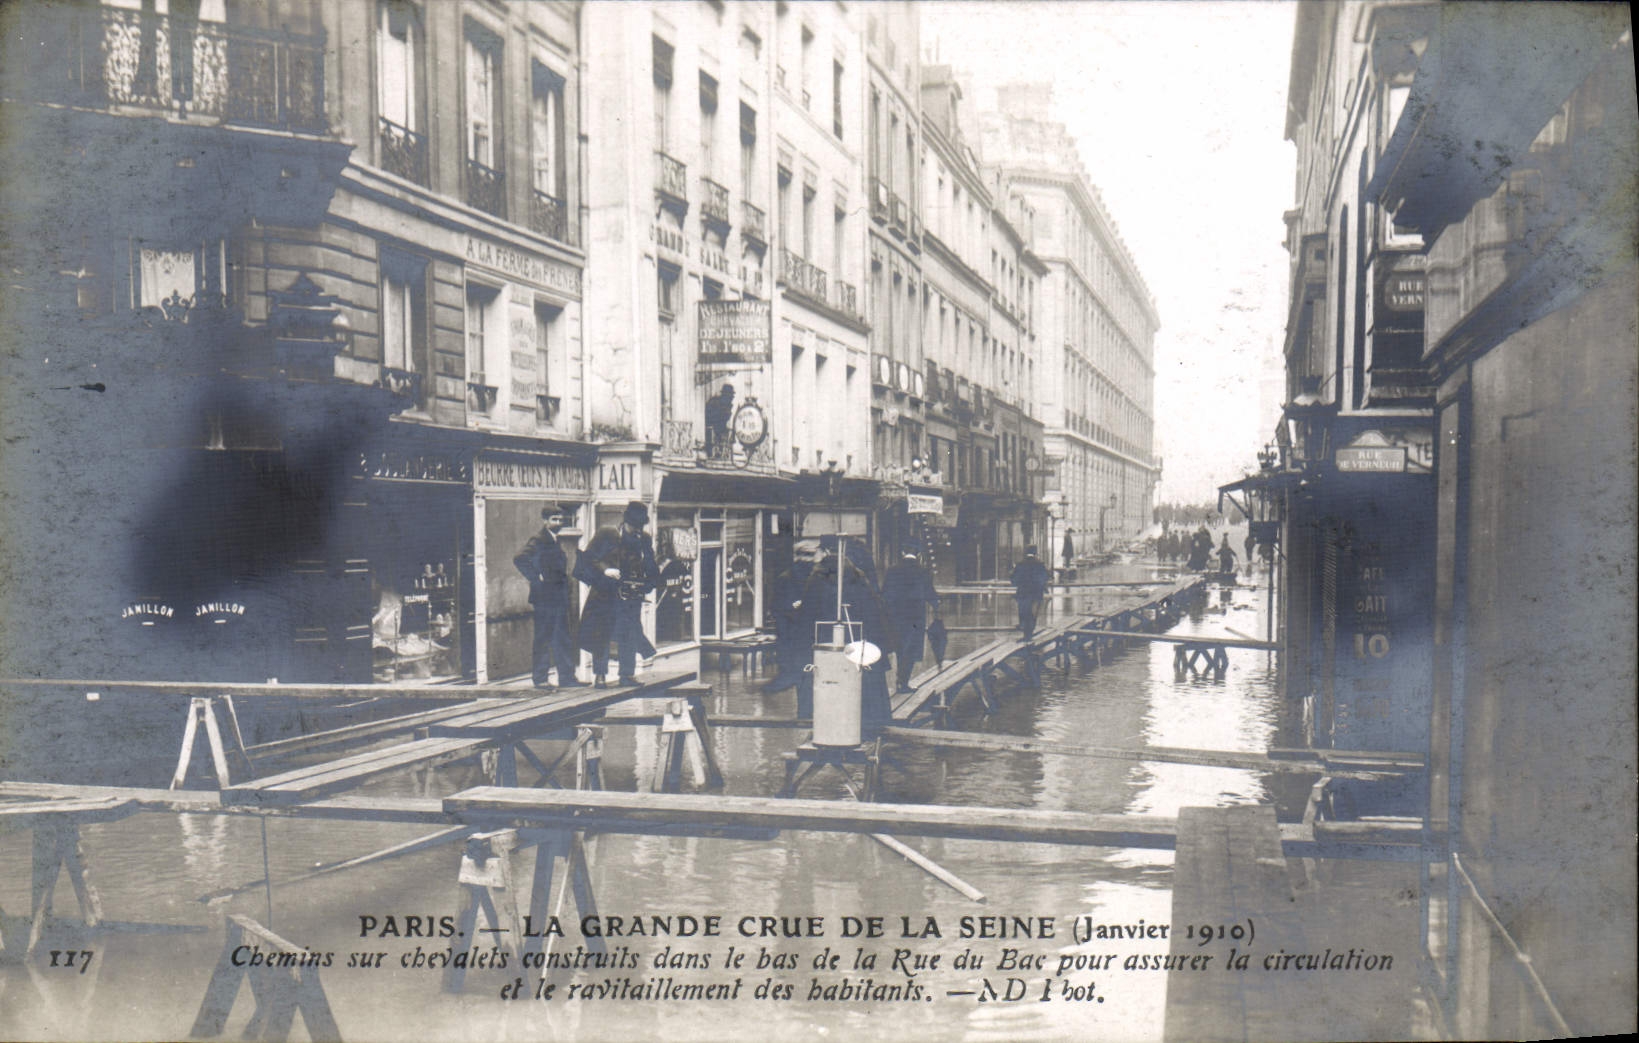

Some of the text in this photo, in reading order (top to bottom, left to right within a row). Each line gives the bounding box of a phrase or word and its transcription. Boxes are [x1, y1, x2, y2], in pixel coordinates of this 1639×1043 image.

[478, 242, 494, 266] LA
[495, 247, 531, 279] FERME
[1398, 279, 1424, 291] RUE
[699, 300, 770, 321] RESTAURANT
[1357, 450, 1383, 460] RUE
[477, 462, 515, 487] BEURRE
[598, 463, 637, 490] LAIT
[121, 603, 174, 618] JAMILLON
[195, 602, 246, 616] JAMILLON
